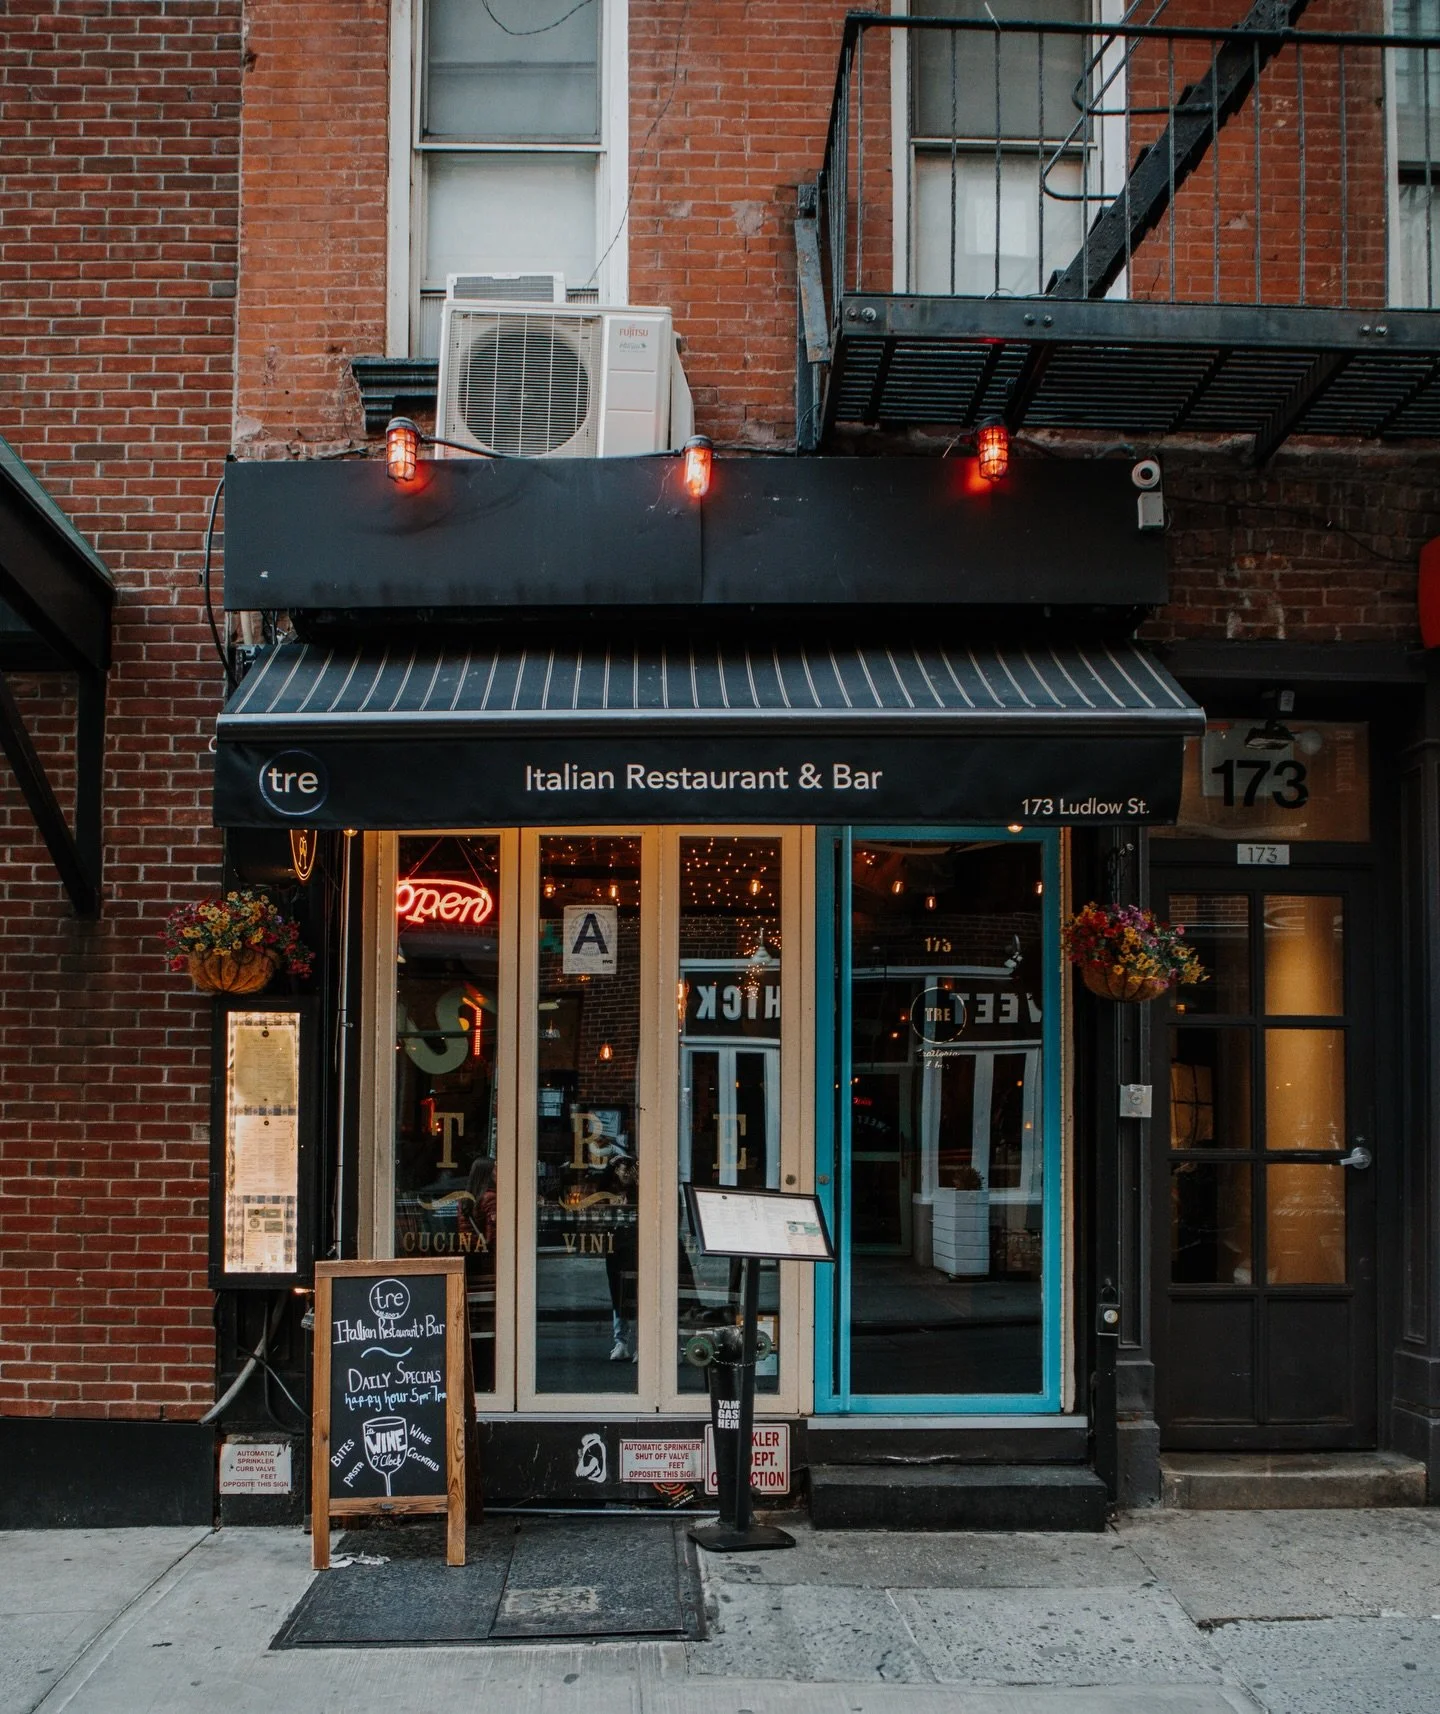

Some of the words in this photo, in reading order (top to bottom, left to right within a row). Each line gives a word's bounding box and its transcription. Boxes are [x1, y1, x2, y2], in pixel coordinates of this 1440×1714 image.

[619, 327, 649, 338] FUJITSU
[267, 766, 319, 794] tre
[526, 763, 615, 791] Italian
[626, 764, 789, 790] Restaurant
[798, 762, 823, 789] &
[832, 763, 883, 790] Bar
[1211, 758, 1310, 810] 173
[1021, 798, 1053, 815] 173
[1059, 798, 1123, 815] Ludlow
[1127, 798, 1151, 815] St.
[1248, 846, 1278, 864] 173
[571, 912, 609, 954] A
[924, 936, 952, 953] 173
[924, 1007, 951, 1022] TRE
[402, 1231, 489, 1253] CUCINA
[562, 1231, 615, 1254] VINI
[373, 1287, 405, 1309] tre
[332, 1318, 377, 1345] Italian
[425, 1314, 446, 1338] Bar
[348, 1368, 391, 1393] DAILY
[345, 1393, 381, 1412] happy
[384, 1390, 408, 1411] hour
[366, 1428, 407, 1455] WINE
[624, 1443, 662, 1451] AUTOMATIC
[663, 1443, 701, 1451] SPRINKLER
[330, 1438, 355, 1468] BITES
[635, 1452, 653, 1460] SHUT
[654, 1452, 667, 1460] OFF
[668, 1452, 689, 1460] VALVE
[752, 1451, 778, 1467] EPT.
[342, 1461, 365, 1488] PASTA
[629, 1470, 661, 1478] OPPOSITE
[663, 1470, 679, 1478] THIS
[668, 1461, 685, 1469] FEET
